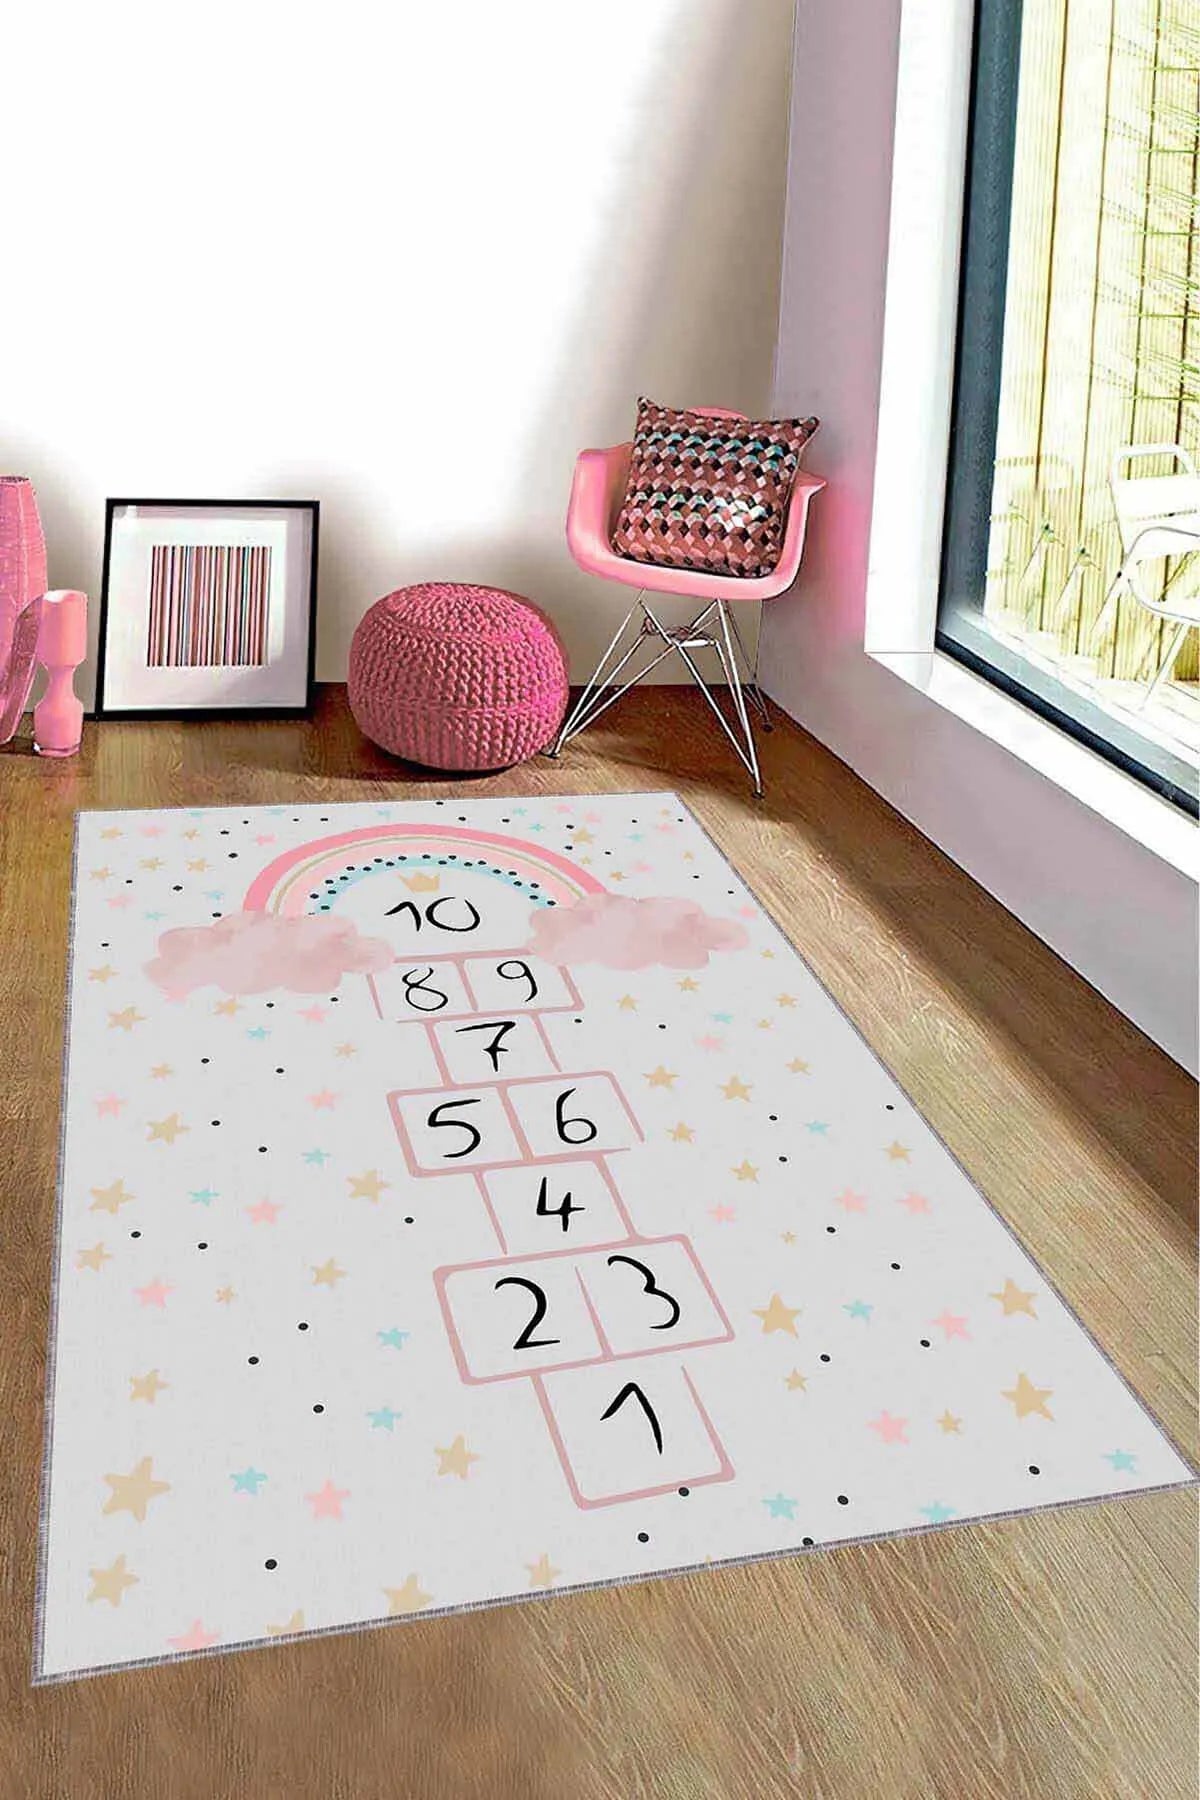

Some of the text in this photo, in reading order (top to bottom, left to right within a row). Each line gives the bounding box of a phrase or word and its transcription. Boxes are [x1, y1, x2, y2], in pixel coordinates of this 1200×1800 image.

[384, 896, 481, 932] 10
[401, 960, 538, 1012] 8 9
[455, 1020, 516, 1072] 7
[427, 1087, 597, 1158] 5 6
[536, 1176, 586, 1232] 4
[494, 1255, 681, 1350] 2 3
[599, 1382, 663, 1455] 1
